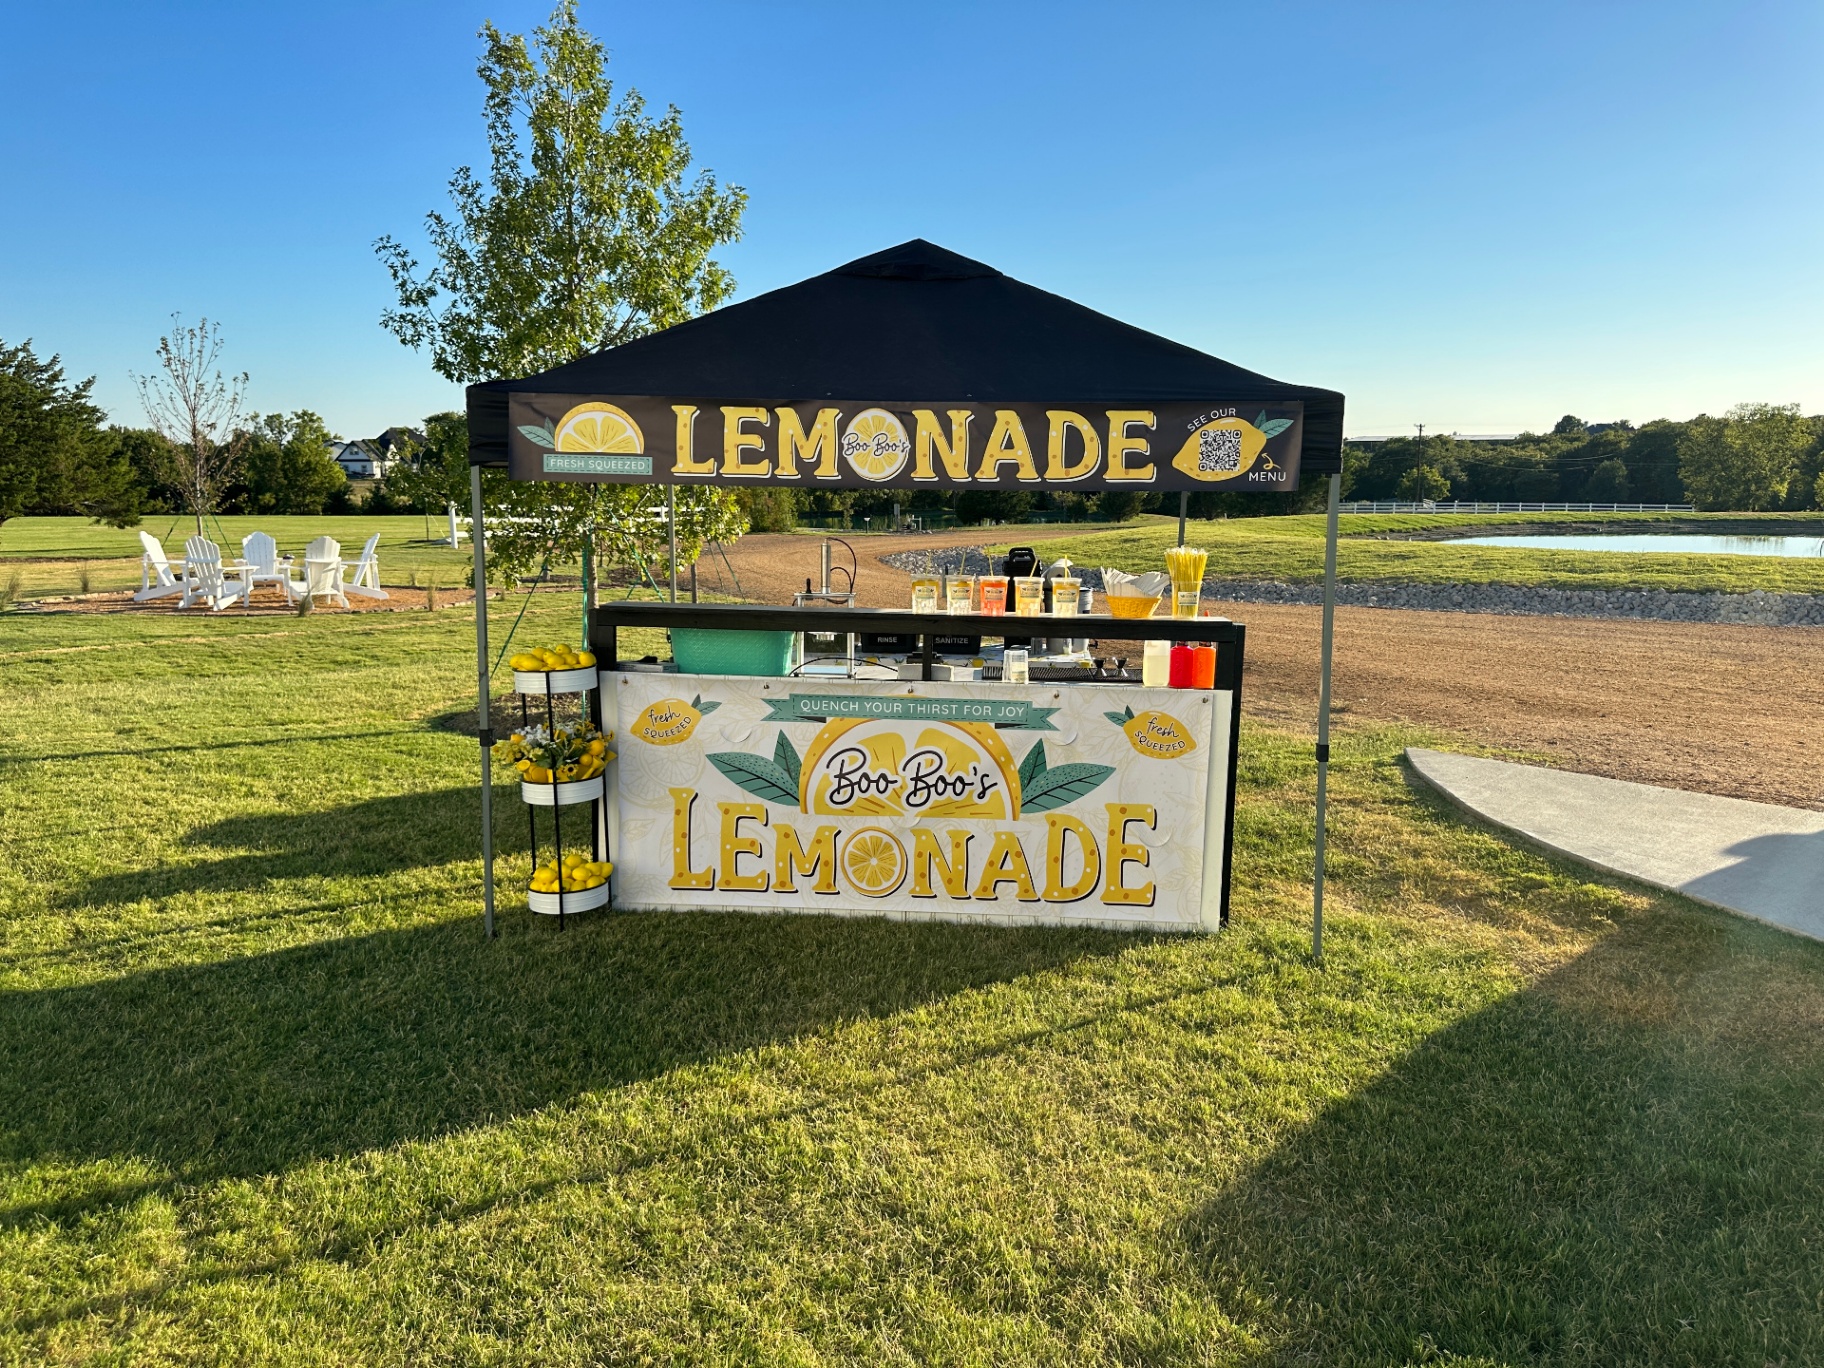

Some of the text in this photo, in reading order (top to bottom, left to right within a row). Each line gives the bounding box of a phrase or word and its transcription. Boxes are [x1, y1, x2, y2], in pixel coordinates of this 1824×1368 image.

[1187, 407, 1236, 432] SEE OUR
[671, 404, 1156, 483] LEMONADE
[843, 432, 909, 457] Boo Boo's
[550, 458, 645, 471] FRESH SQUEEZED
[1248, 471, 1287, 482] MENU
[648, 704, 681, 727] fresh
[800, 699, 1025, 717] QUENCH YOUR THIRST FOR JOY
[643, 716, 692, 738] SQUEEZED
[1147, 717, 1180, 737] fresh
[1134, 730, 1186, 751] SQUEEZED
[825, 747, 998, 808] Boo Boo's
[667, 787, 1157, 907] LEMONADE
